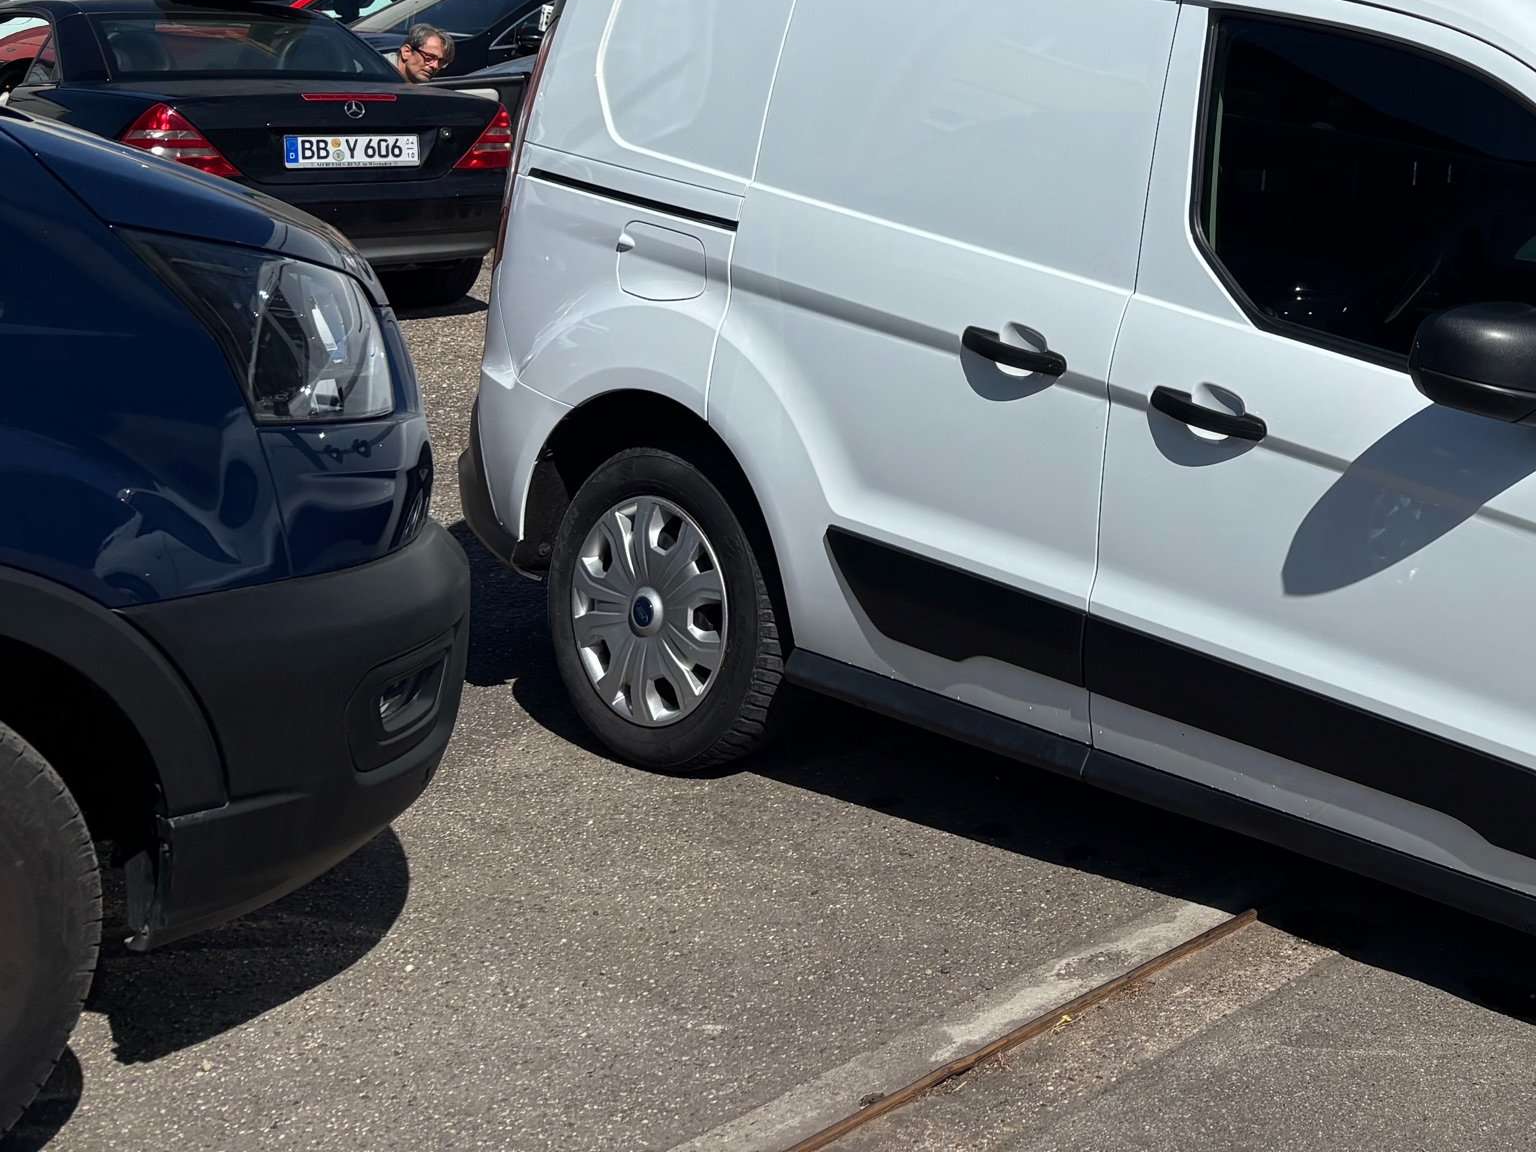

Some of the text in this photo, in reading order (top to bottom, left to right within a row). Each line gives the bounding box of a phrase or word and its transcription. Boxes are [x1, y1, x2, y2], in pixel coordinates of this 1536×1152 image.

[300, 138, 403, 160] BB Y 606
